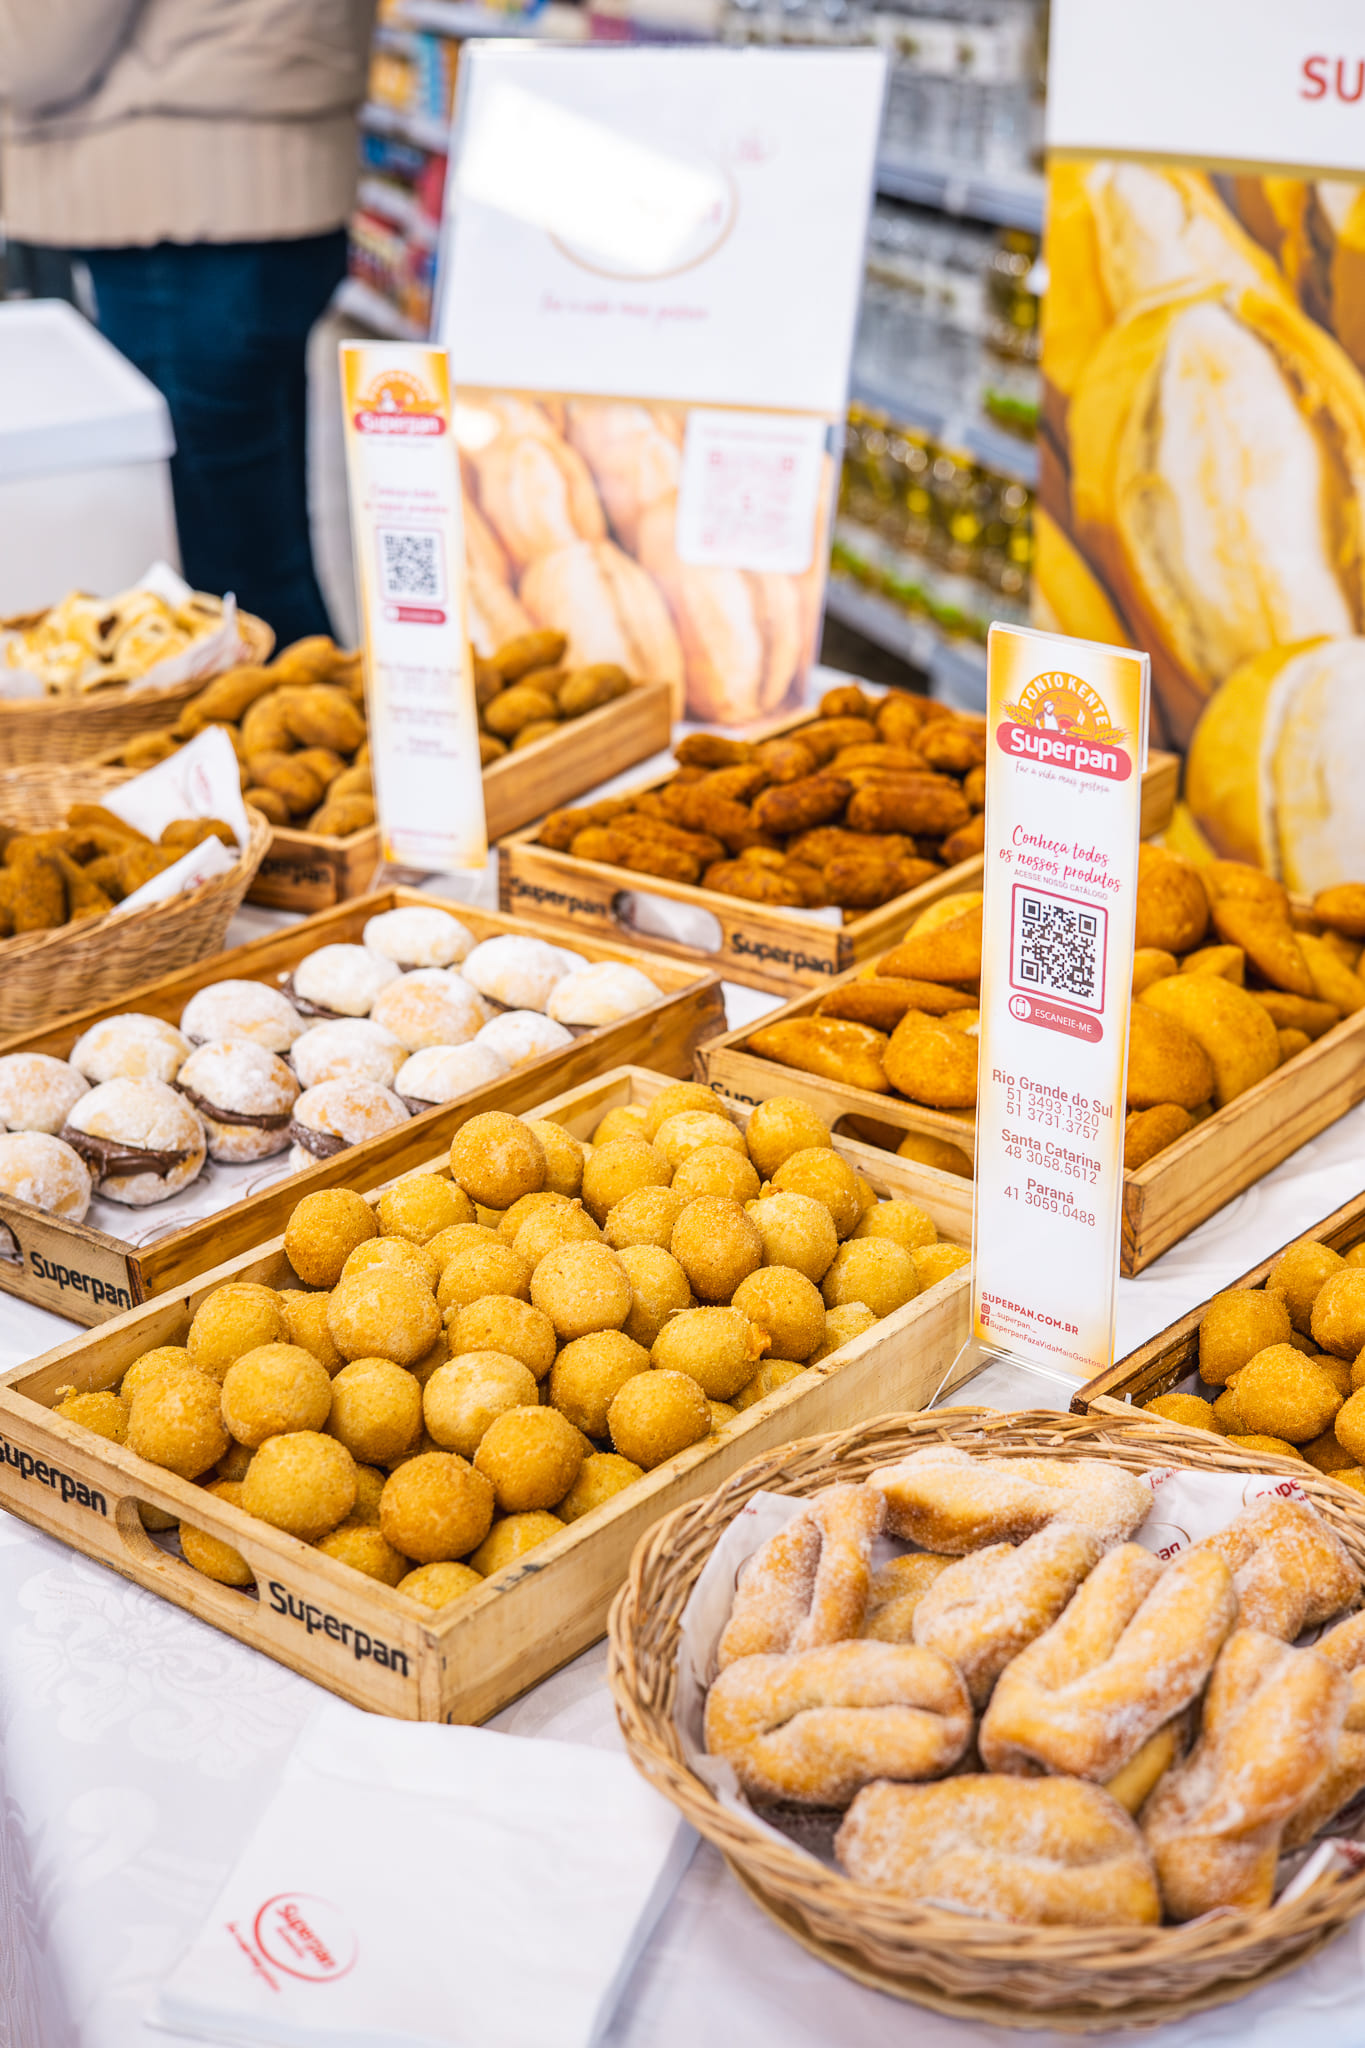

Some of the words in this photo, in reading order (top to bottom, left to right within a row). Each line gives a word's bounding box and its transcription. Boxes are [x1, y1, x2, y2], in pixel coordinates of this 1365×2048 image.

[1020, 673, 1064, 710] PONTO
[1067, 676, 1109, 727] KENTE
[1010, 728, 1118, 772] Superpan
[1012, 825, 1069, 857] Conheça
[1073, 842, 1110, 868] todos
[999, 848, 1014, 863] os
[1018, 852, 1060, 875] nossos
[1063, 863, 1122, 892] produtos
[1014, 869, 1041, 881] ACESSE
[1043, 876, 1068, 889] NOSSO
[509, 877, 607, 918] Superpan
[731, 932, 834, 976] Superpan
[1034, 1008, 1092, 1033] ESCANEIE-ME
[992, 1069, 1015, 1085] Rio
[1019, 1077, 1068, 1102] Grande
[1072, 1093, 1088, 1108] do
[1093, 1100, 1113, 1119] Sul
[1007, 1087, 1021, 1102] 51
[1028, 1092, 1099, 1127] 3493.1320
[1006, 1101, 1020, 1117] 51
[1027, 1107, 1099, 1141] 3731.3757
[1001, 1128, 1041, 1151] Santa
[1045, 1142, 1101, 1172] Catarina
[1004, 1144, 1022, 1159] 48
[1026, 1149, 1097, 1184] 3058.5612
[1003, 1186, 1019, 1200] 41
[1025, 1191, 1096, 1226] 3059.0488
[1027, 1178, 1074, 1205] Paraná
[30, 1251, 132, 1310] Superpan
[981, 1291, 1079, 1335] SUPERPAN.COM.BR
[269, 1580, 409, 1677] Superpan
